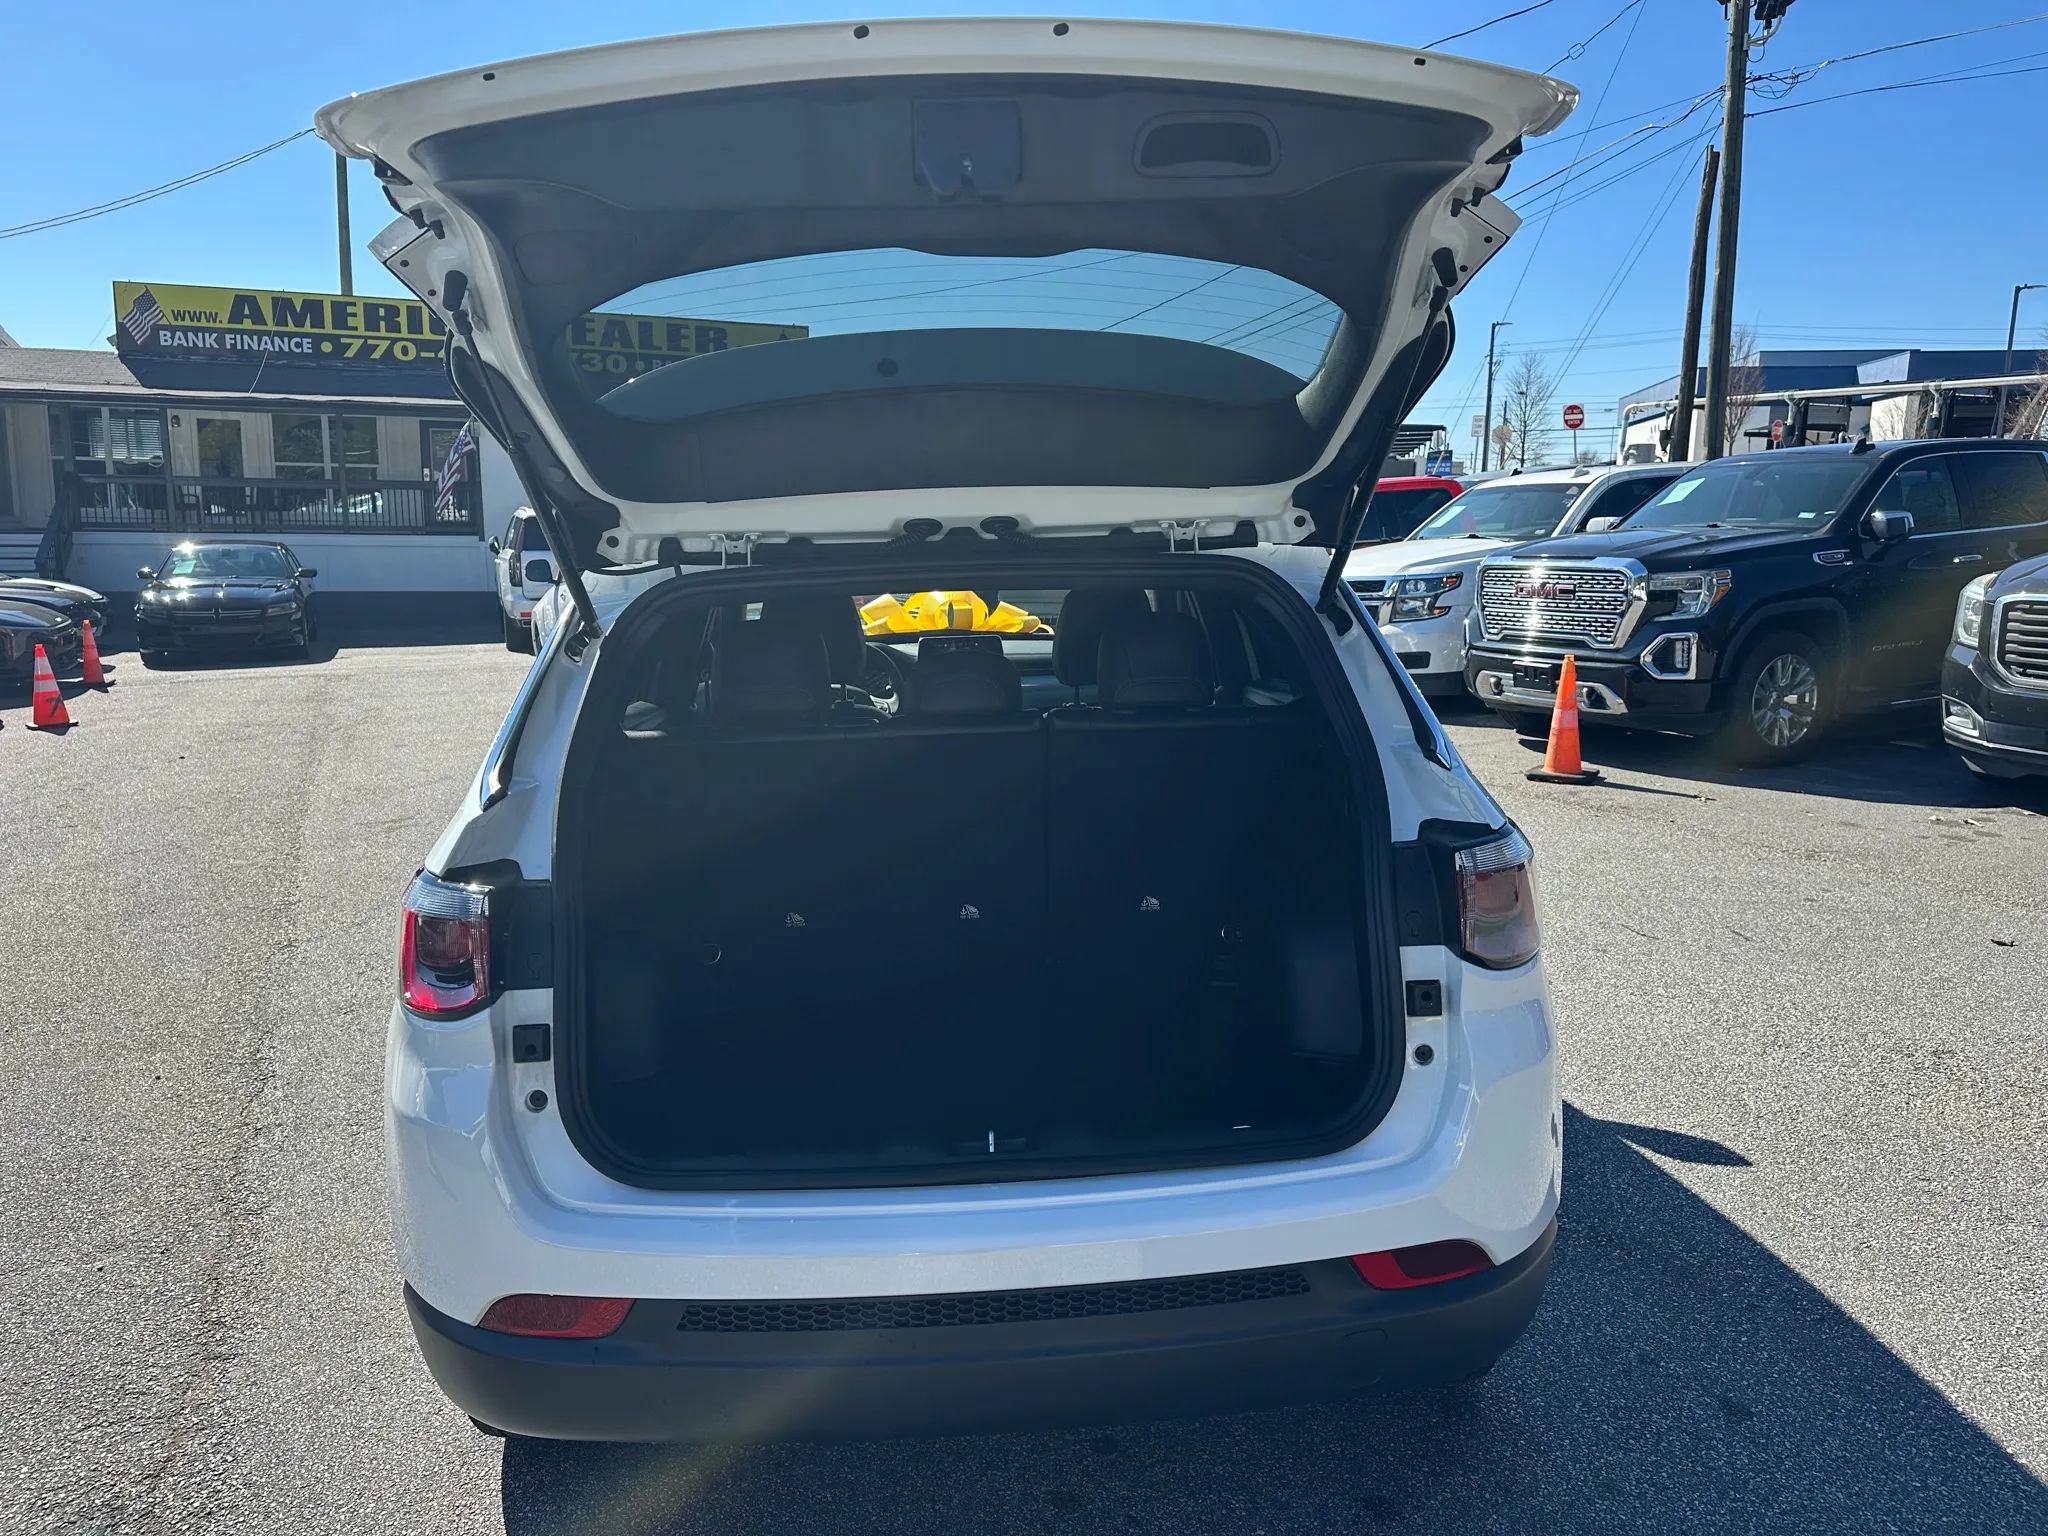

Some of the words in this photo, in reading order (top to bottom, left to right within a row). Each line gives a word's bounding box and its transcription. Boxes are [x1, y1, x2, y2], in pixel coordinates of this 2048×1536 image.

[159, 330, 220, 349] BANK
[225, 333, 314, 354] FINANCE
[340, 337, 446, 361] 770-
[571, 317, 729, 352] EALER
[1514, 581, 1576, 600] GMC
